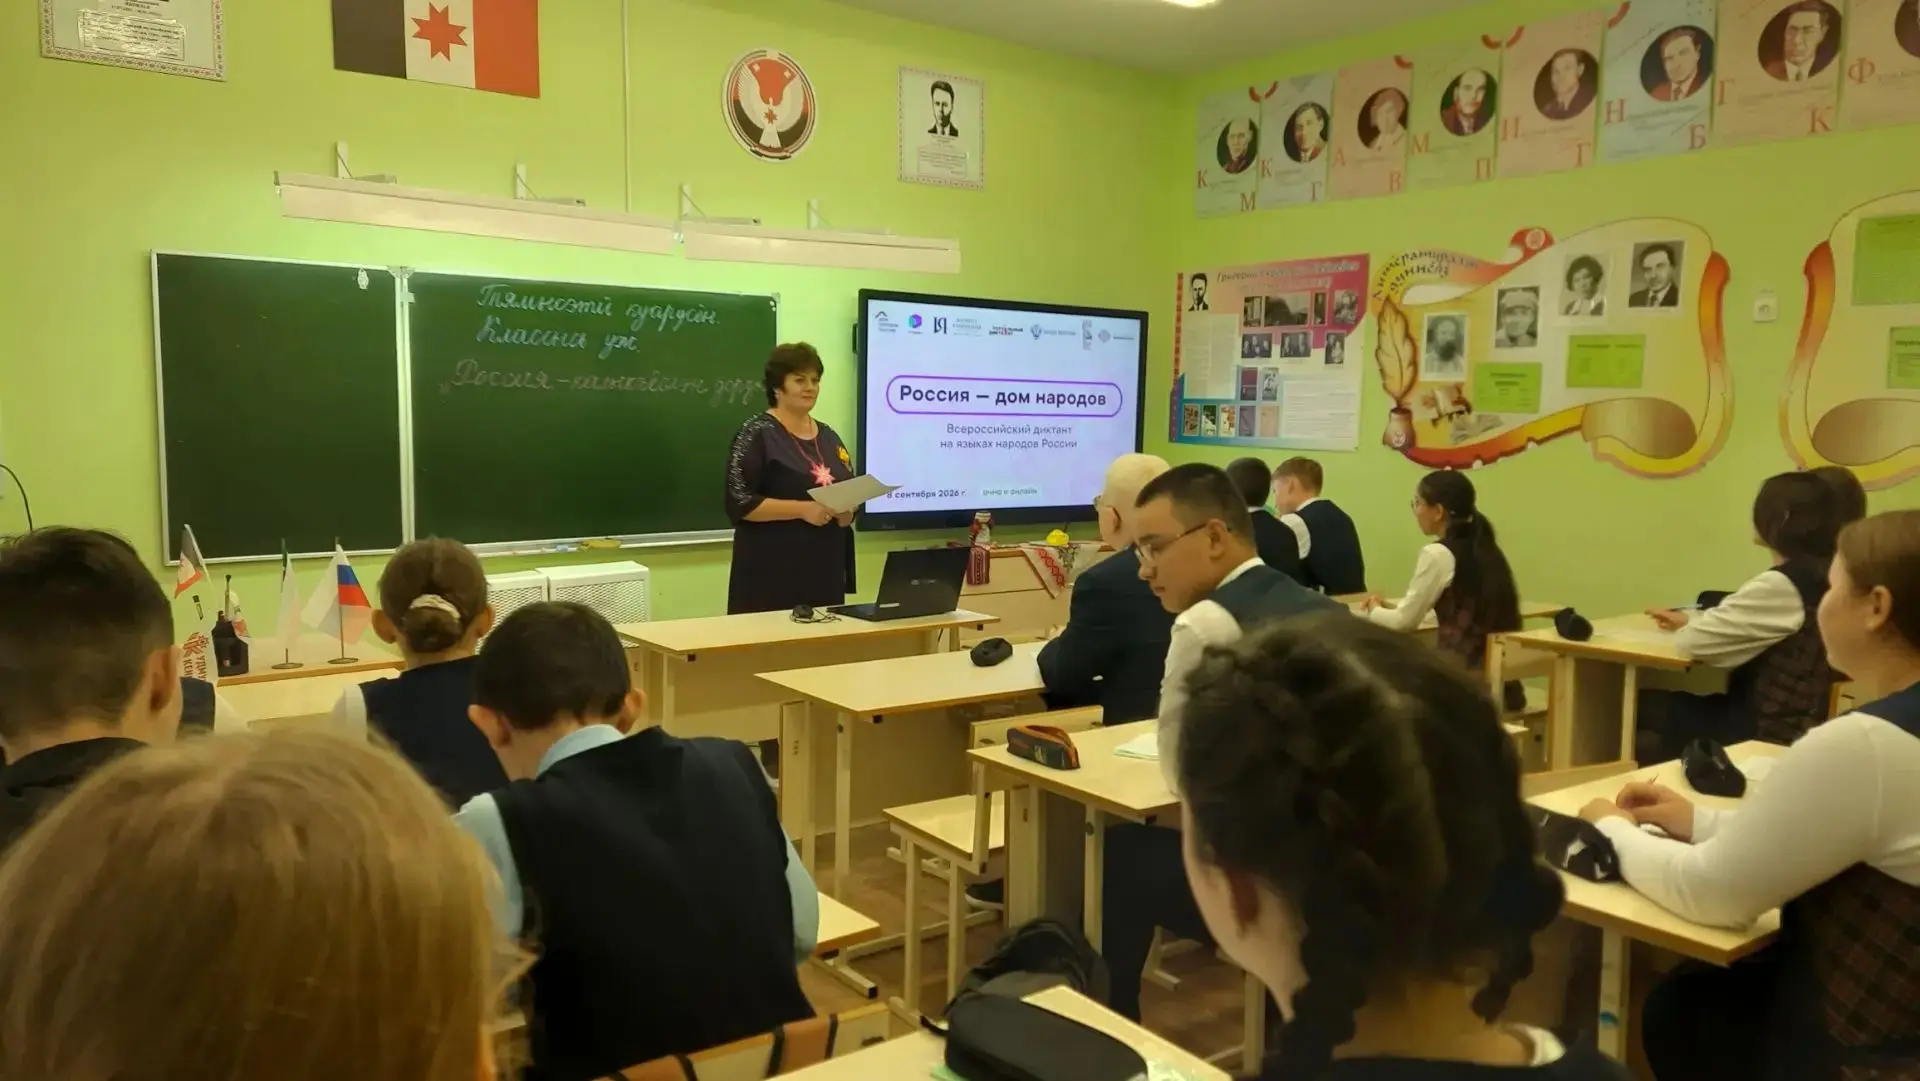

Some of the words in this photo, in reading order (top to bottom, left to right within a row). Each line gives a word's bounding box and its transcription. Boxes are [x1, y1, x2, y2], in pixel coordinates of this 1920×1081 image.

[1848, 57, 1875, 84] Ф
[1717, 78, 1735, 106] Г
[1605, 98, 1626, 125] Н
[1808, 106, 1833, 133] К
[1412, 131, 1430, 155] М
[1688, 124, 1706, 150] Б
[1261, 158, 1273, 179] К
[1333, 149, 1346, 169] А
[1197, 170, 1208, 190] К
[1389, 171, 1402, 192] В
[1240, 191, 1257, 213] М
[900, 385, 970, 403] Россия
[995, 391, 1030, 407] дом
[1036, 391, 1107, 408] народов
[947, 423, 1031, 436] Всероссийский
[1033, 425, 1072, 436] диктант
[940, 440, 953, 449] на
[956, 440, 993, 449] языках
[996, 441, 1039, 450] народов
[1041, 439, 1078, 449] России
[894, 489, 936, 500] сентября
[937, 489, 959, 498] 2026
